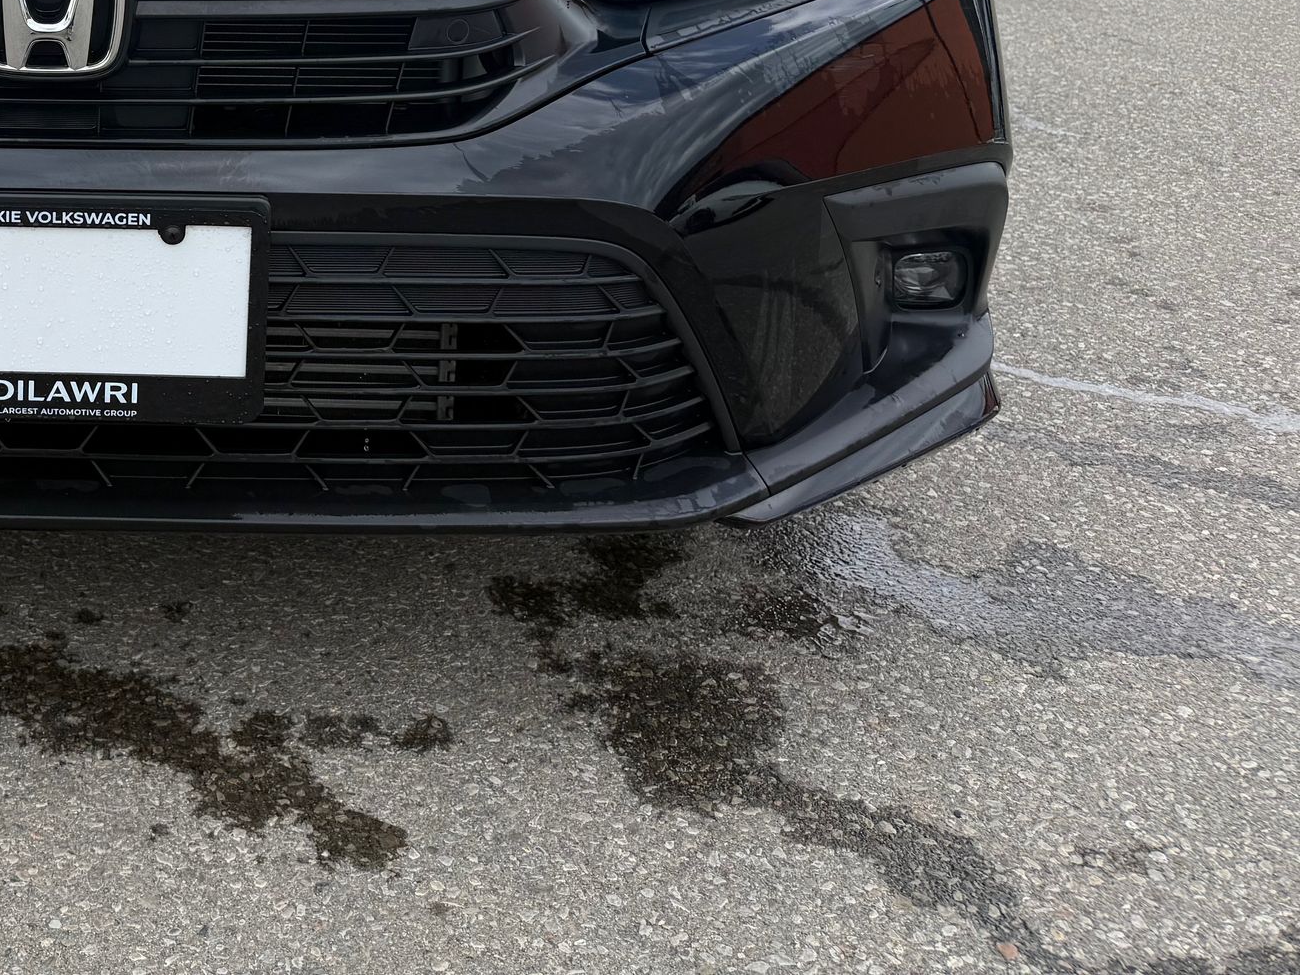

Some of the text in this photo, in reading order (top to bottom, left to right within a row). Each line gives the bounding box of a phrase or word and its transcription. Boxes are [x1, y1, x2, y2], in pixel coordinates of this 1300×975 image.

[25, 210, 151, 226] VOLKSWAGEN
[40, 408, 102, 417] AUTOMOTIVE
[103, 409, 138, 417] GROUP
